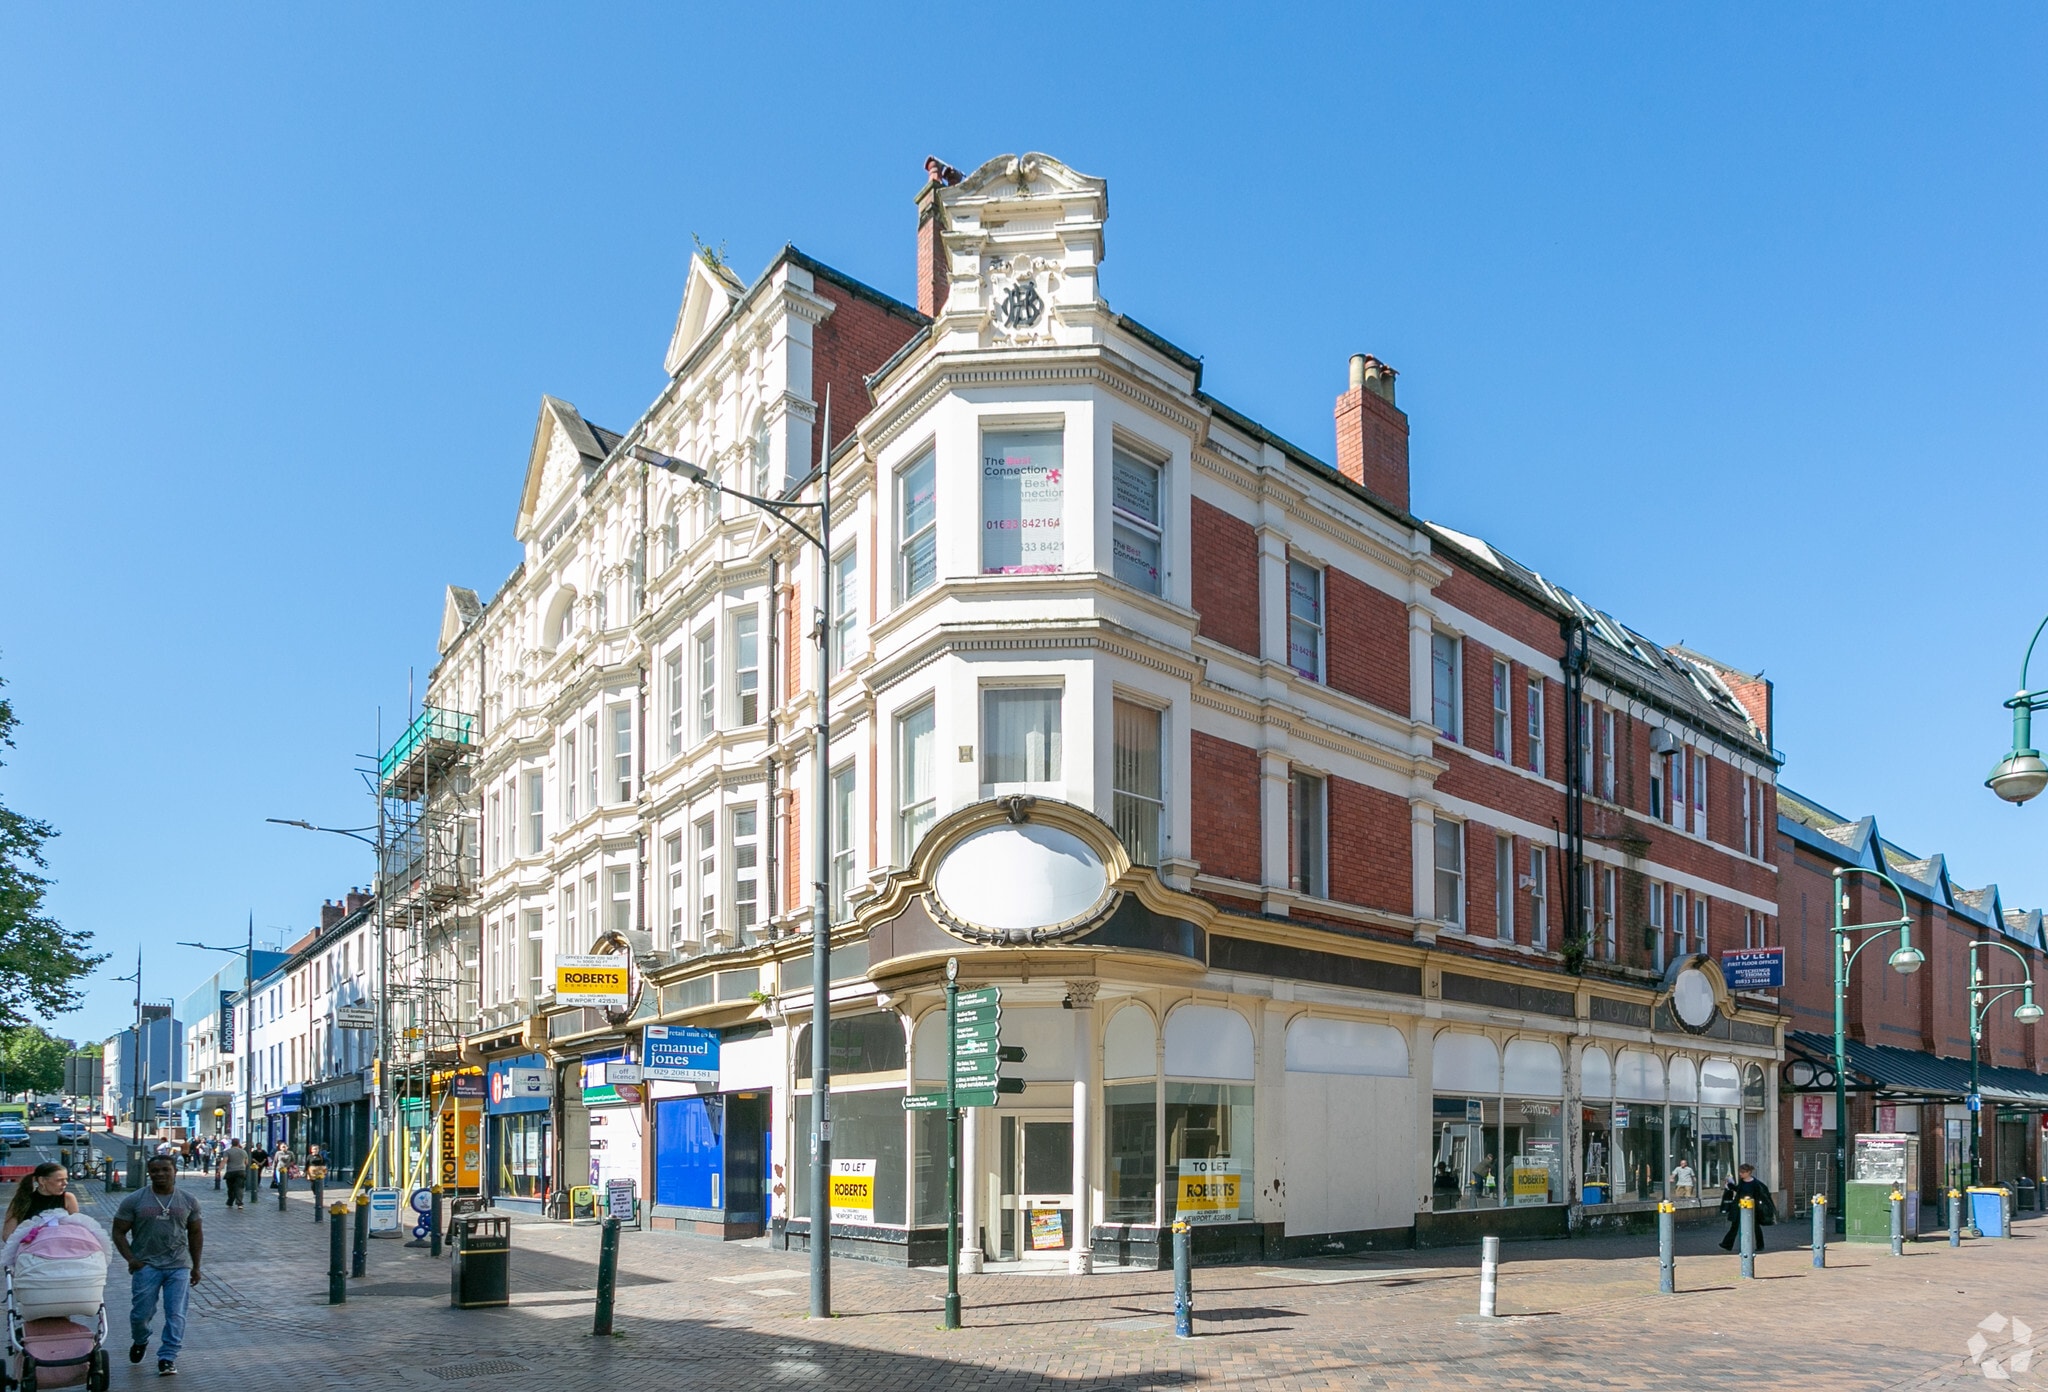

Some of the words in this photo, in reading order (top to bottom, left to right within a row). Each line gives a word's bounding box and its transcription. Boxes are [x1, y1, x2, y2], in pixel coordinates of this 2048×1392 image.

[985, 457, 1005, 466] The
[985, 466, 1048, 476] Connection
[1120, 469, 1147, 487] INDUSTRIAL
[1117, 493, 1150, 512] DISTRIBUTION
[987, 519, 1018, 529] 01633
[1021, 518, 1060, 528] 842164
[1126, 545, 1140, 556] Best
[1113, 548, 1151, 568] Connection
[565, 973, 619, 984] ROBERTS
[651, 1042, 708, 1054] emanuel
[650, 1052, 689, 1067] jones
[442, 1112, 456, 1184] ROBERTS
[841, 1163, 850, 1172] TO
[852, 1163, 866, 1172] LET
[1193, 1162, 1207, 1172] TO
[1211, 1162, 1229, 1172] LET
[1518, 1174, 1546, 1184] ROBERTS
[834, 1184, 867, 1197] ROBERTS
[1187, 1183, 1235, 1197] ROBERTS
